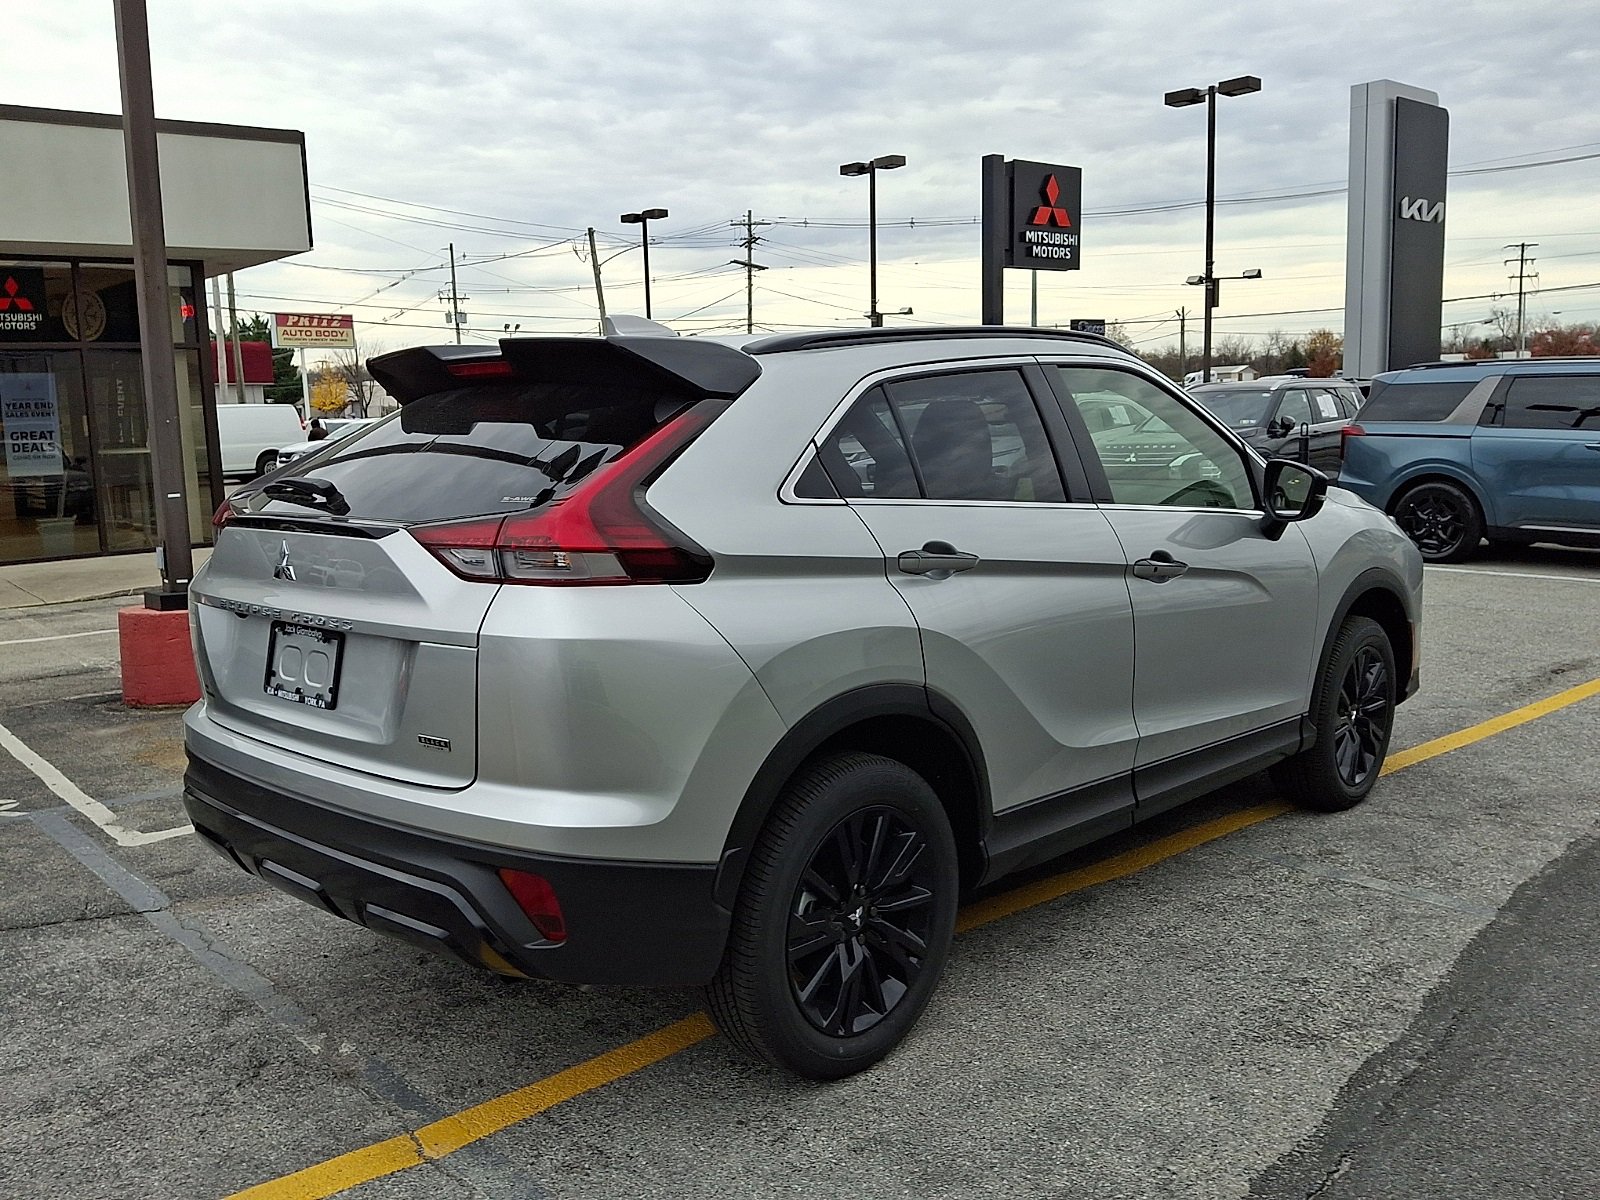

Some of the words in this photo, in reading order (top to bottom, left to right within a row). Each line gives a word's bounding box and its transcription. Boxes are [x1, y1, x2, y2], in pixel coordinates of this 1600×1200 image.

[1401, 196, 1445, 223] KIA
[1025, 230, 1078, 246] MITSUBISHI
[1032, 245, 1071, 259] MOTORS
[0, 313, 42, 321] TSUBISHI
[282, 329, 313, 337] AUTO
[315, 330, 345, 338] BODY
[5, 402, 31, 410] YEAR
[34, 401, 54, 409] END
[10, 430, 55, 441] GREAT
[12, 442, 56, 453] DEALS
[220, 599, 281, 619] ECLIPSE
[291, 612, 353, 630] CROSS
[318, 700, 326, 708] PA
